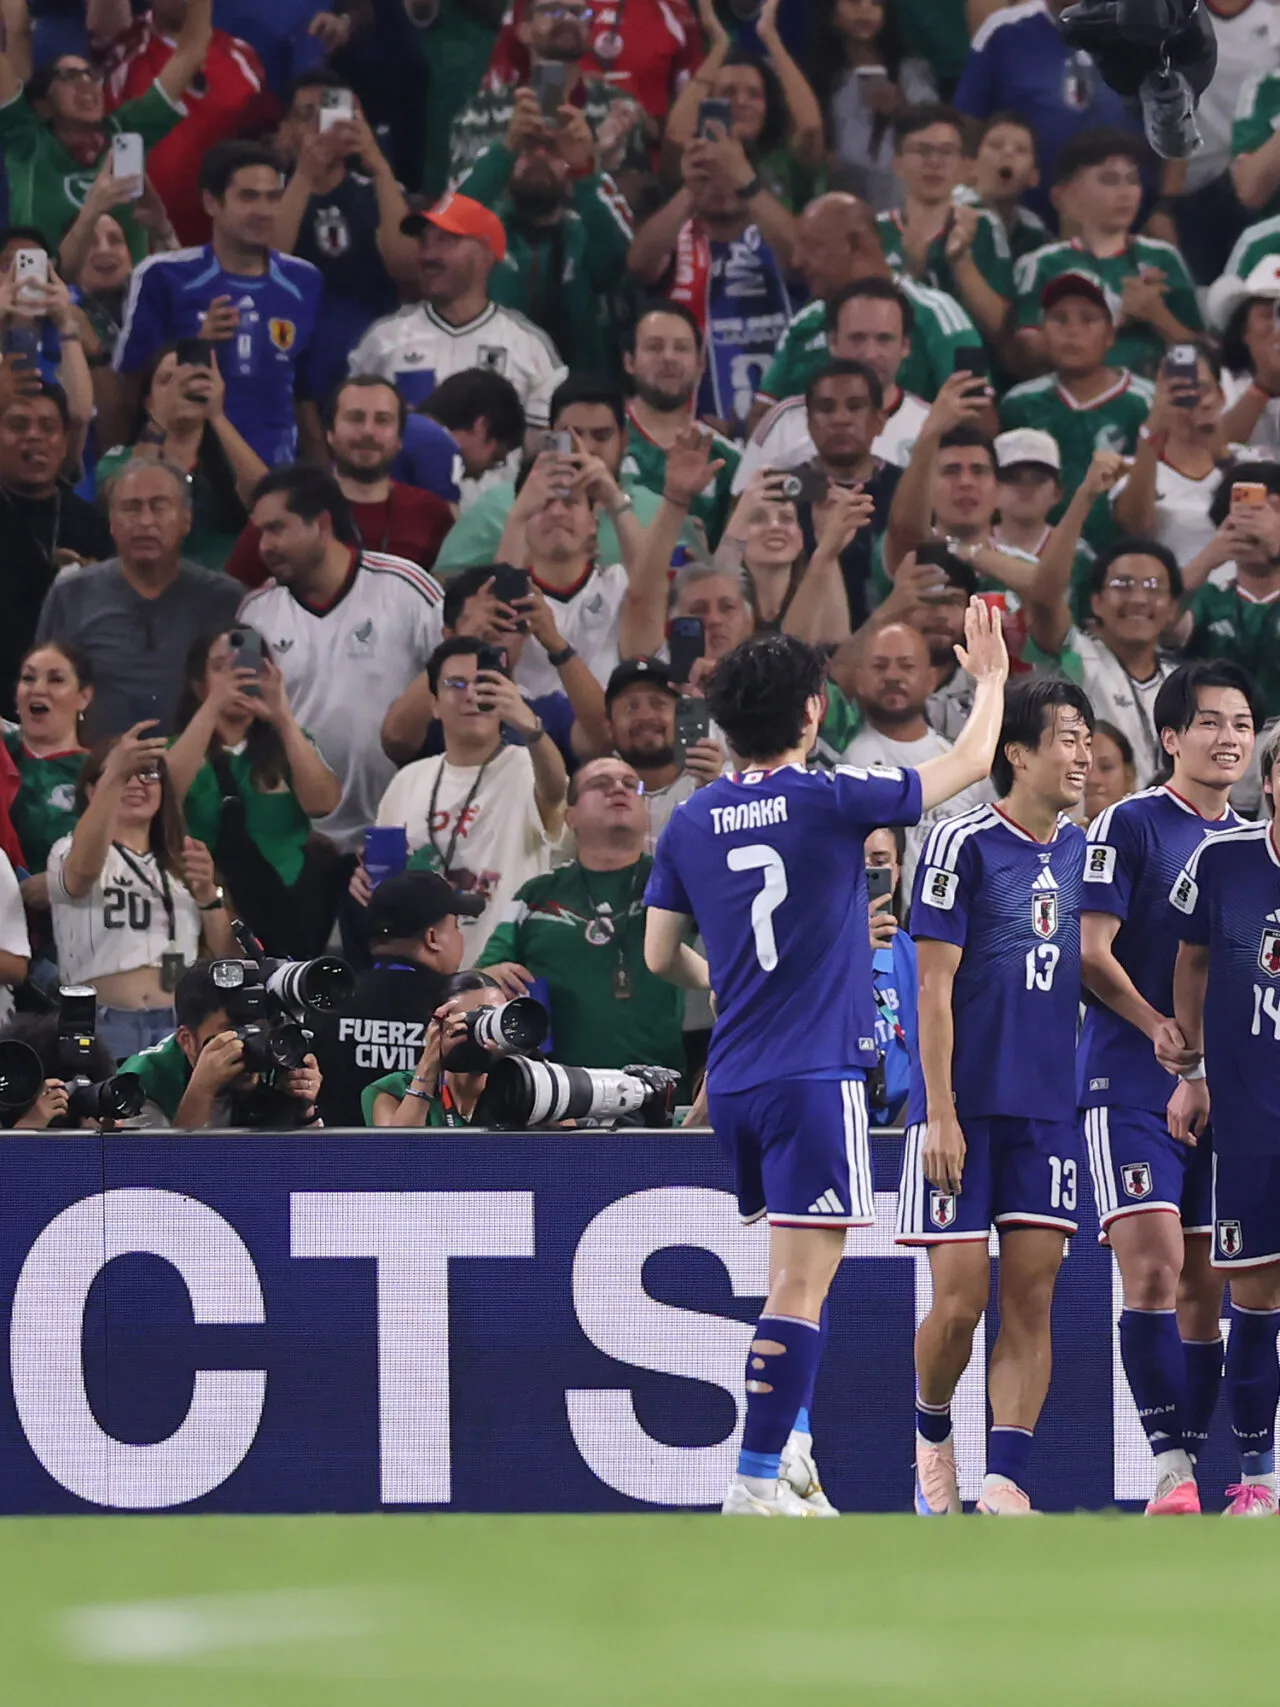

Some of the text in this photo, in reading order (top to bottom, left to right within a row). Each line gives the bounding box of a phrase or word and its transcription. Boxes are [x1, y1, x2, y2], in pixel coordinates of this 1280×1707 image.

[710, 796, 788, 834] TANAKA
[104, 887, 151, 930] 20
[727, 844, 788, 972] 7
[1026, 943, 1060, 991] 13
[339, 1018, 426, 1046] FUERZ
[356, 1044, 418, 1070] CIVIL
[1049, 1156, 1078, 1211] 13
